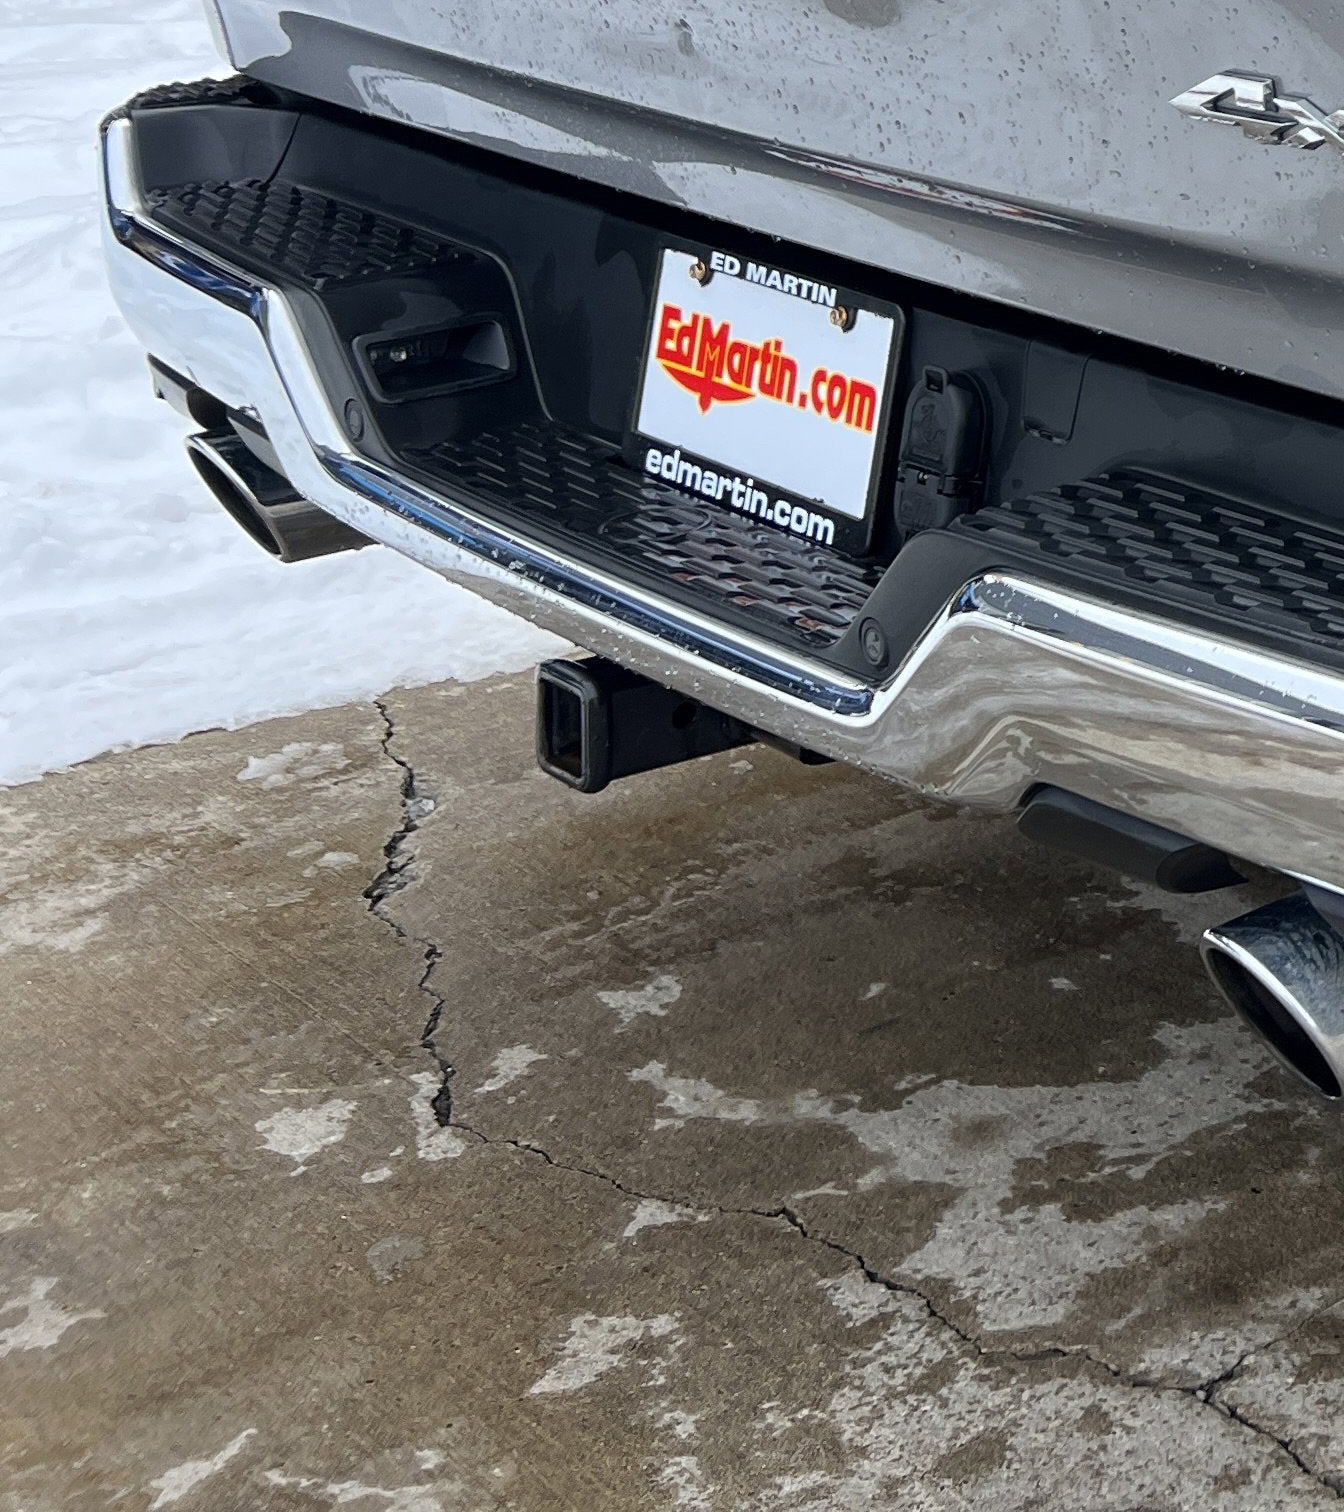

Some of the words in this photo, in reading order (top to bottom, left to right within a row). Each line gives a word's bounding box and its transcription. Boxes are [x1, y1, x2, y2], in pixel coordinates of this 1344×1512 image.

[710, 250, 740, 276] ED
[746, 262, 837, 307] MARTIN
[655, 303, 878, 433] EdMartin.com
[645, 448, 835, 545] edmartin.com
